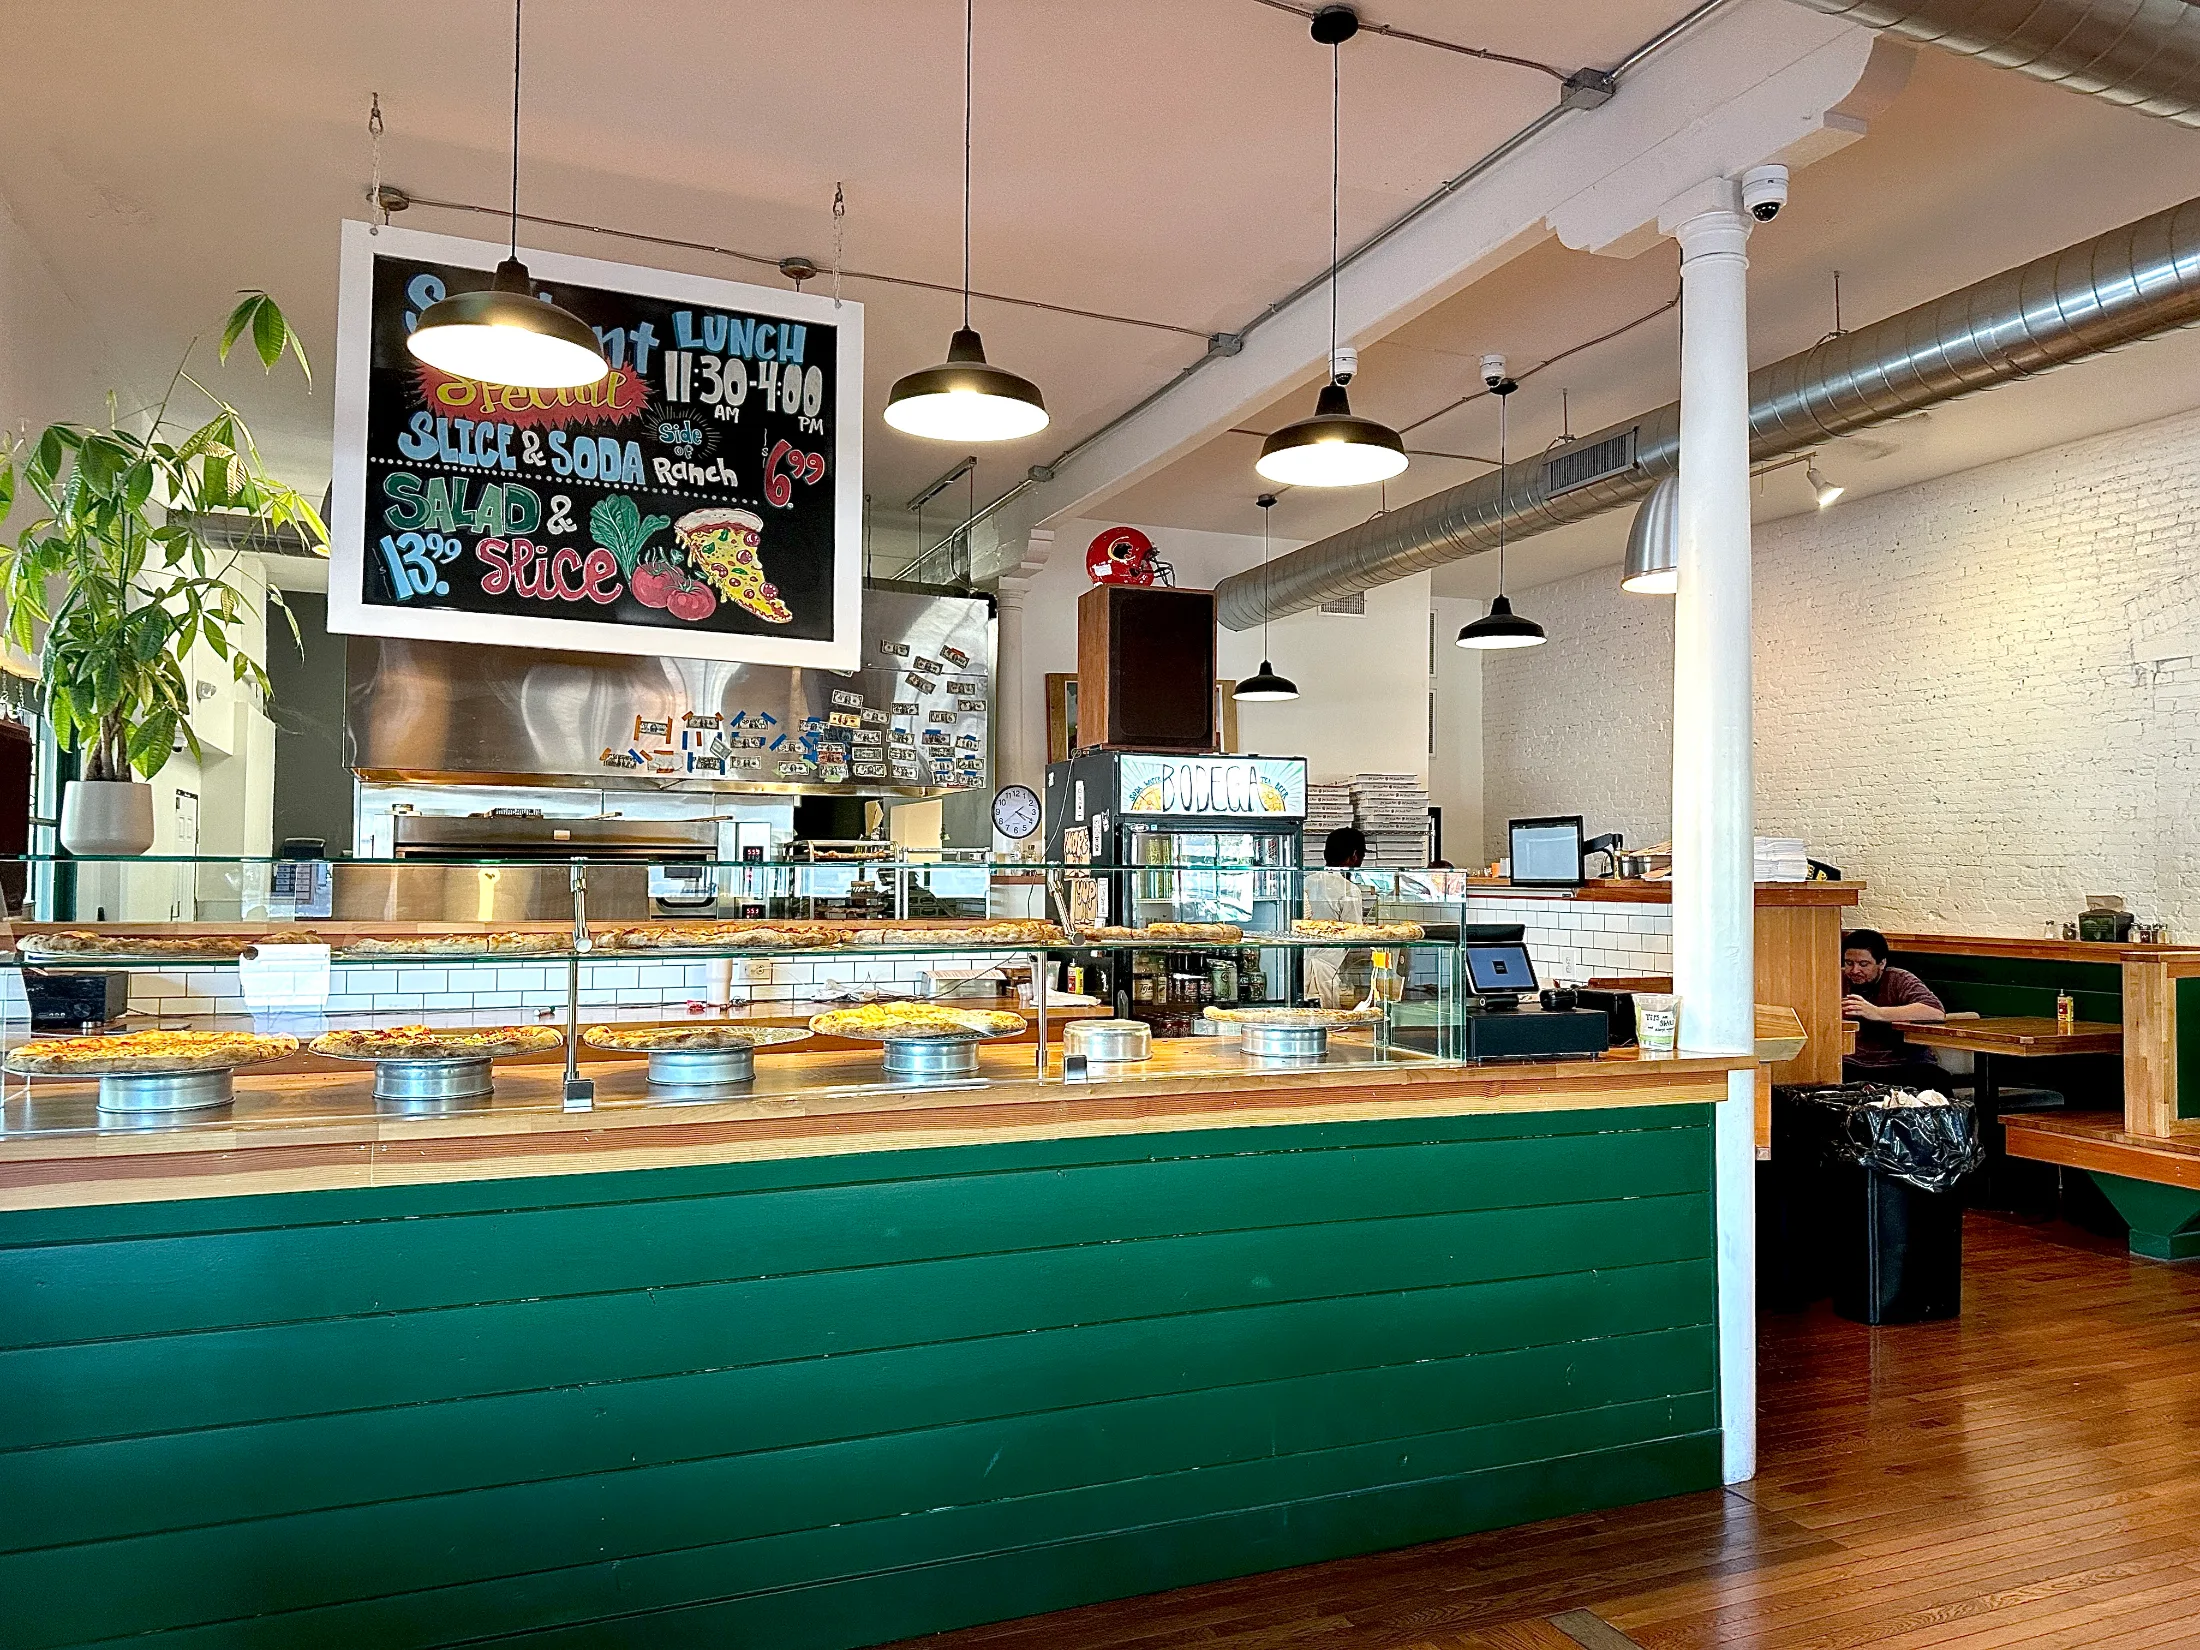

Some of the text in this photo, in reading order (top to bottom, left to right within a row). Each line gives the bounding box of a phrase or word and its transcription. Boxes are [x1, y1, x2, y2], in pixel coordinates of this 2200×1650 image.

[672, 311, 806, 364] LUNCH
[714, 405, 740, 424] AM
[798, 416, 824, 436] PM
[398, 411, 646, 485] SLICE & SODA
[658, 420, 703, 445] Side
[652, 457, 739, 488] Ranch
[382, 472, 578, 538] SALAD &
[1012, 790, 1020, 798] 12
[1162, 763, 1268, 814] BODEGA
